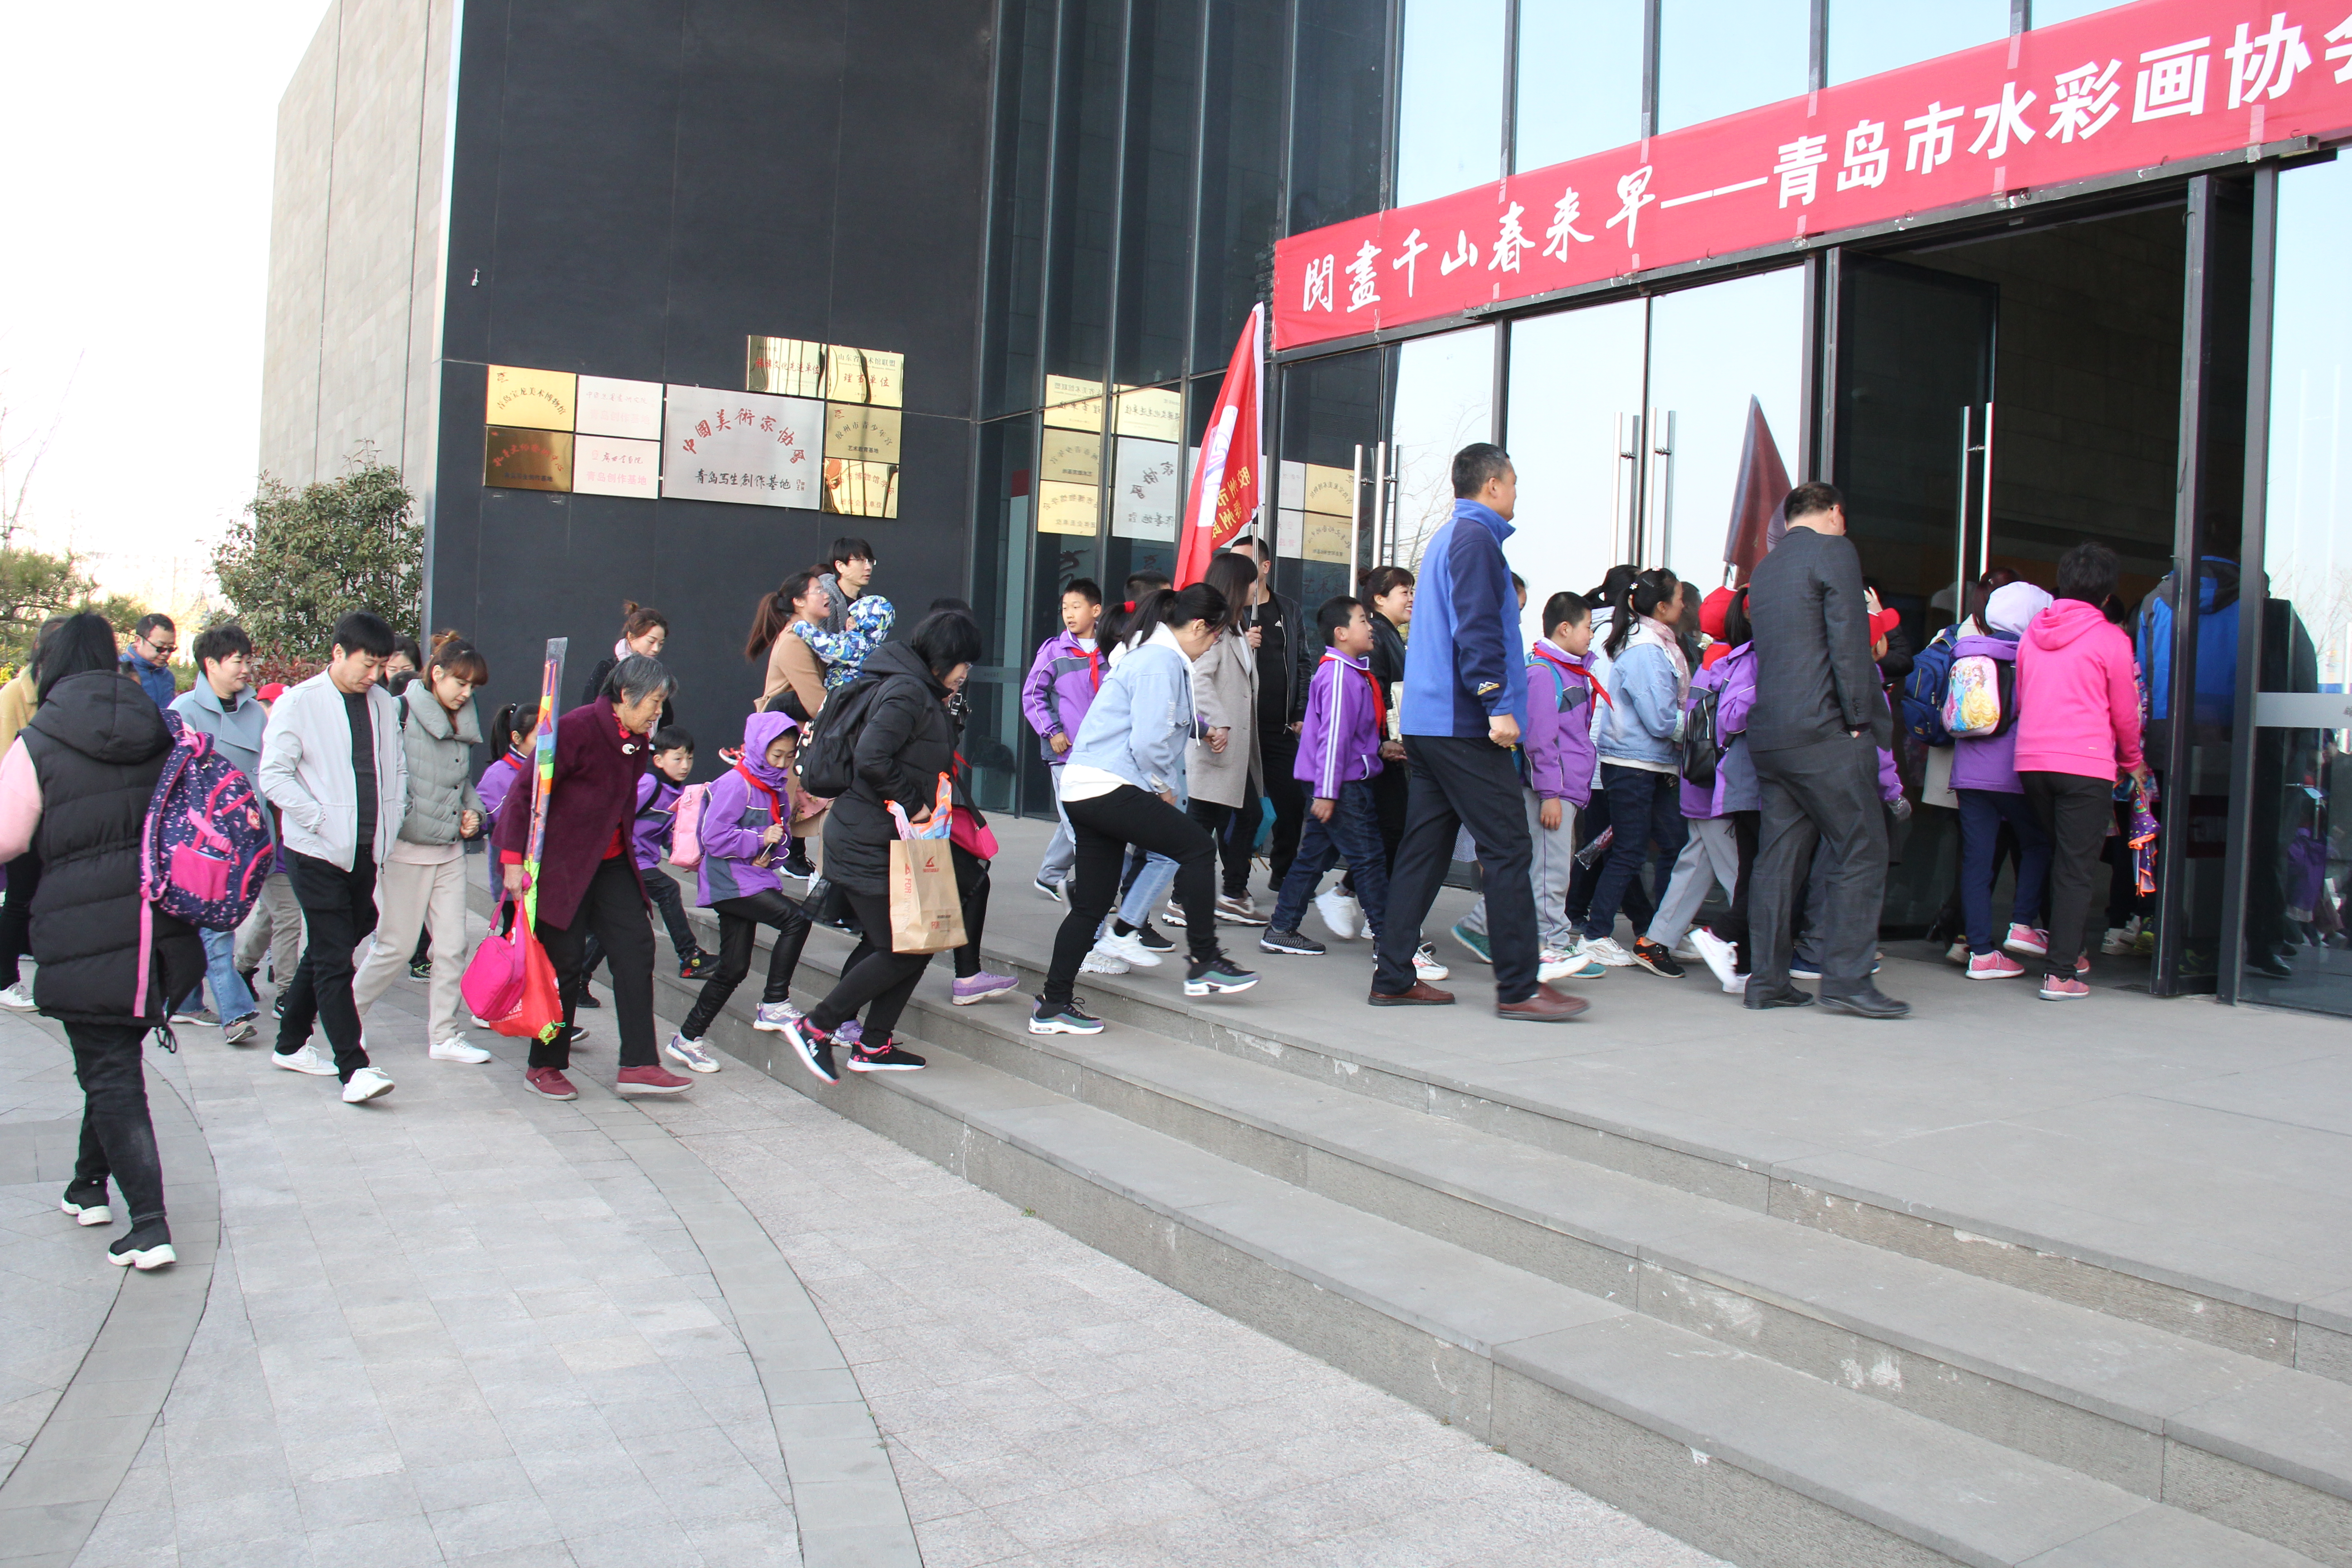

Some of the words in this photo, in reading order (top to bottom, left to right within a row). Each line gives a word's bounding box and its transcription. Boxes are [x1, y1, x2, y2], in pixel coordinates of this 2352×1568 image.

[838, 353, 895, 367] 山东省术馆联盟
[844, 373, 889, 387] 理事单位
[835, 421, 892, 445] 胶州市青少年宫
[848, 446, 879, 454] 艺术教育基地
[587, 471, 647, 485] 青岛创作基地
[841, 499, 882, 508] 团体会员单位
